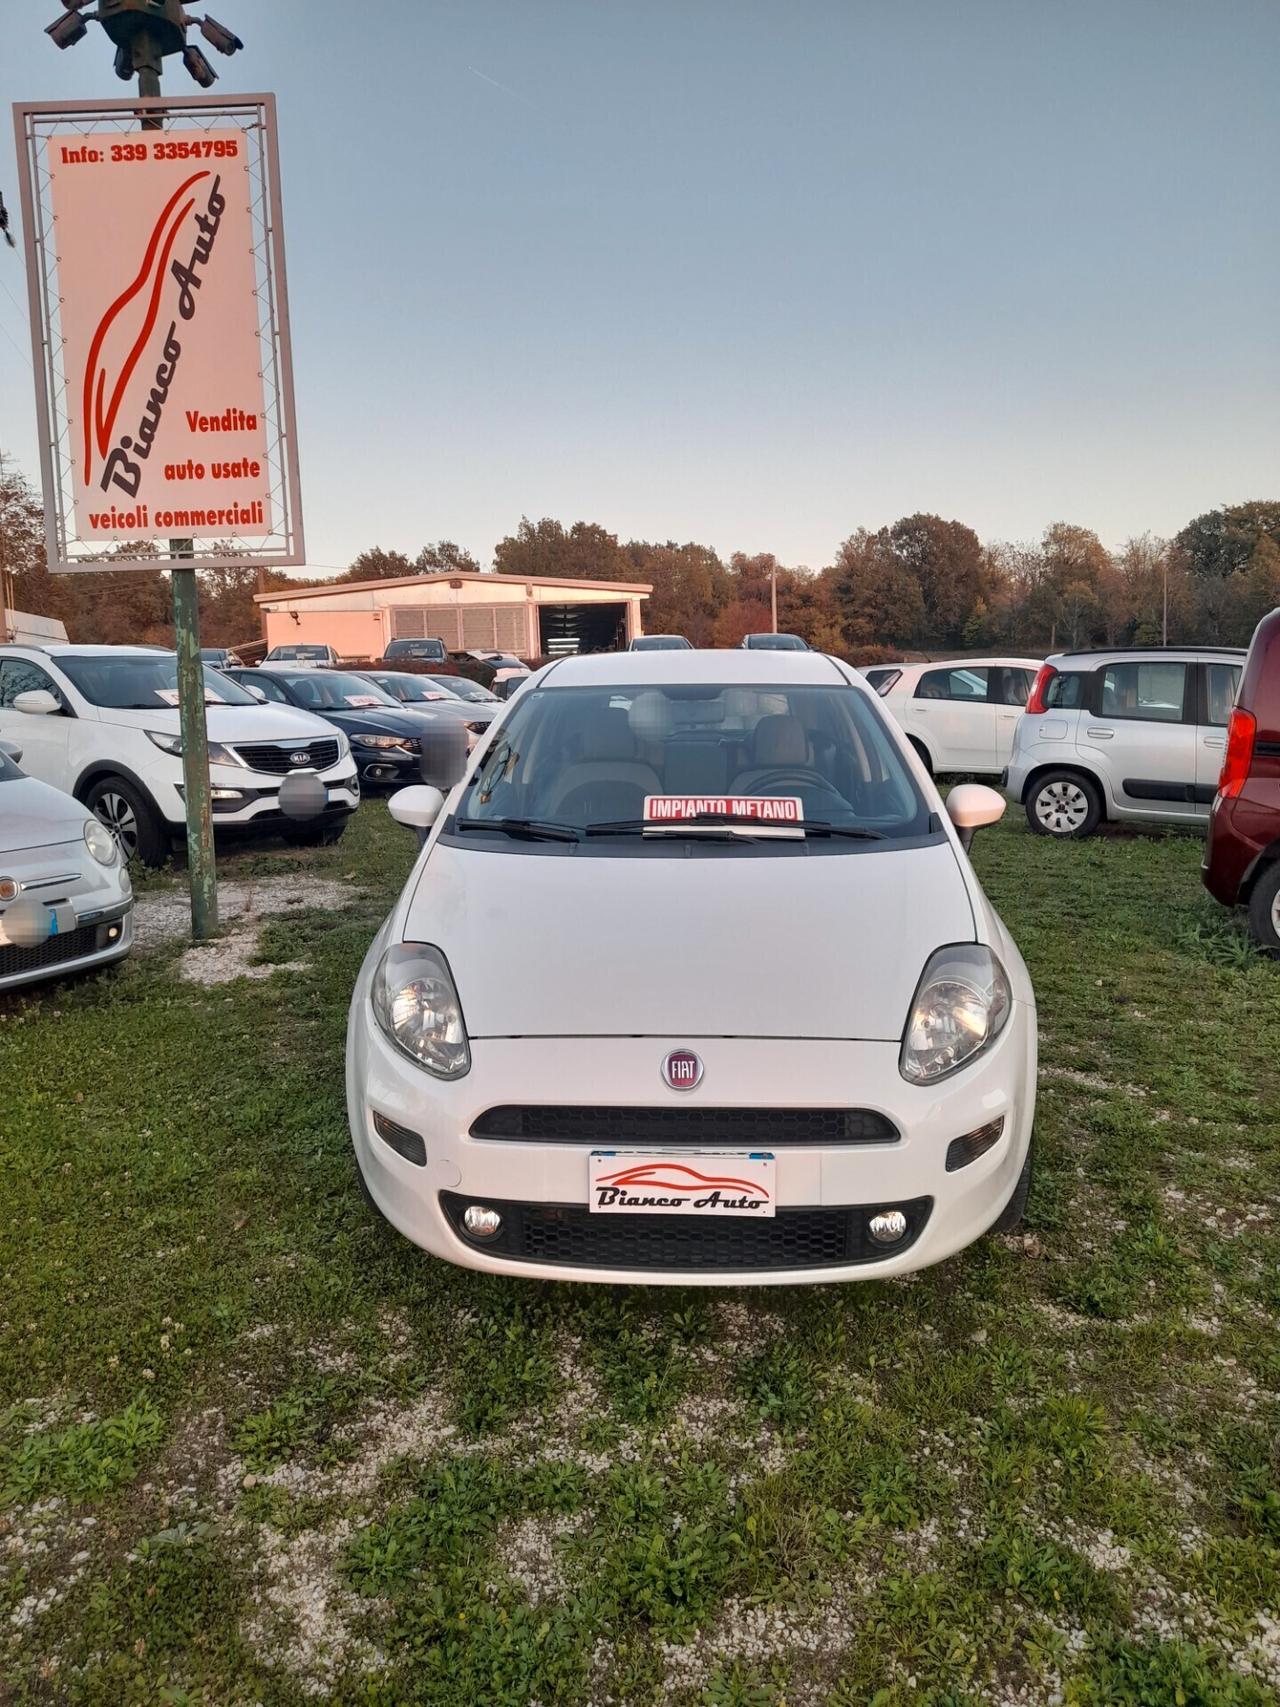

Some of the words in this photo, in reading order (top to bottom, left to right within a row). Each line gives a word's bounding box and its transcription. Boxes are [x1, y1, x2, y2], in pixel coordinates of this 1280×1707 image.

[61, 146, 104, 164] Info:
[111, 143, 147, 162] 339
[153, 140, 238, 160] 3354795
[100, 320, 181, 499] Bianco
[170, 174, 226, 320] Auto
[185, 407, 257, 433] Vendita
[164, 459, 205, 481] auto
[211, 457, 260, 479] usate
[88, 504, 149, 529] veicoli
[154, 500, 264, 528] commerciali
[671, 1060, 695, 1079] FIAT
[595, 1186, 691, 1208] Bianco
[693, 1191, 769, 1210] Auto
